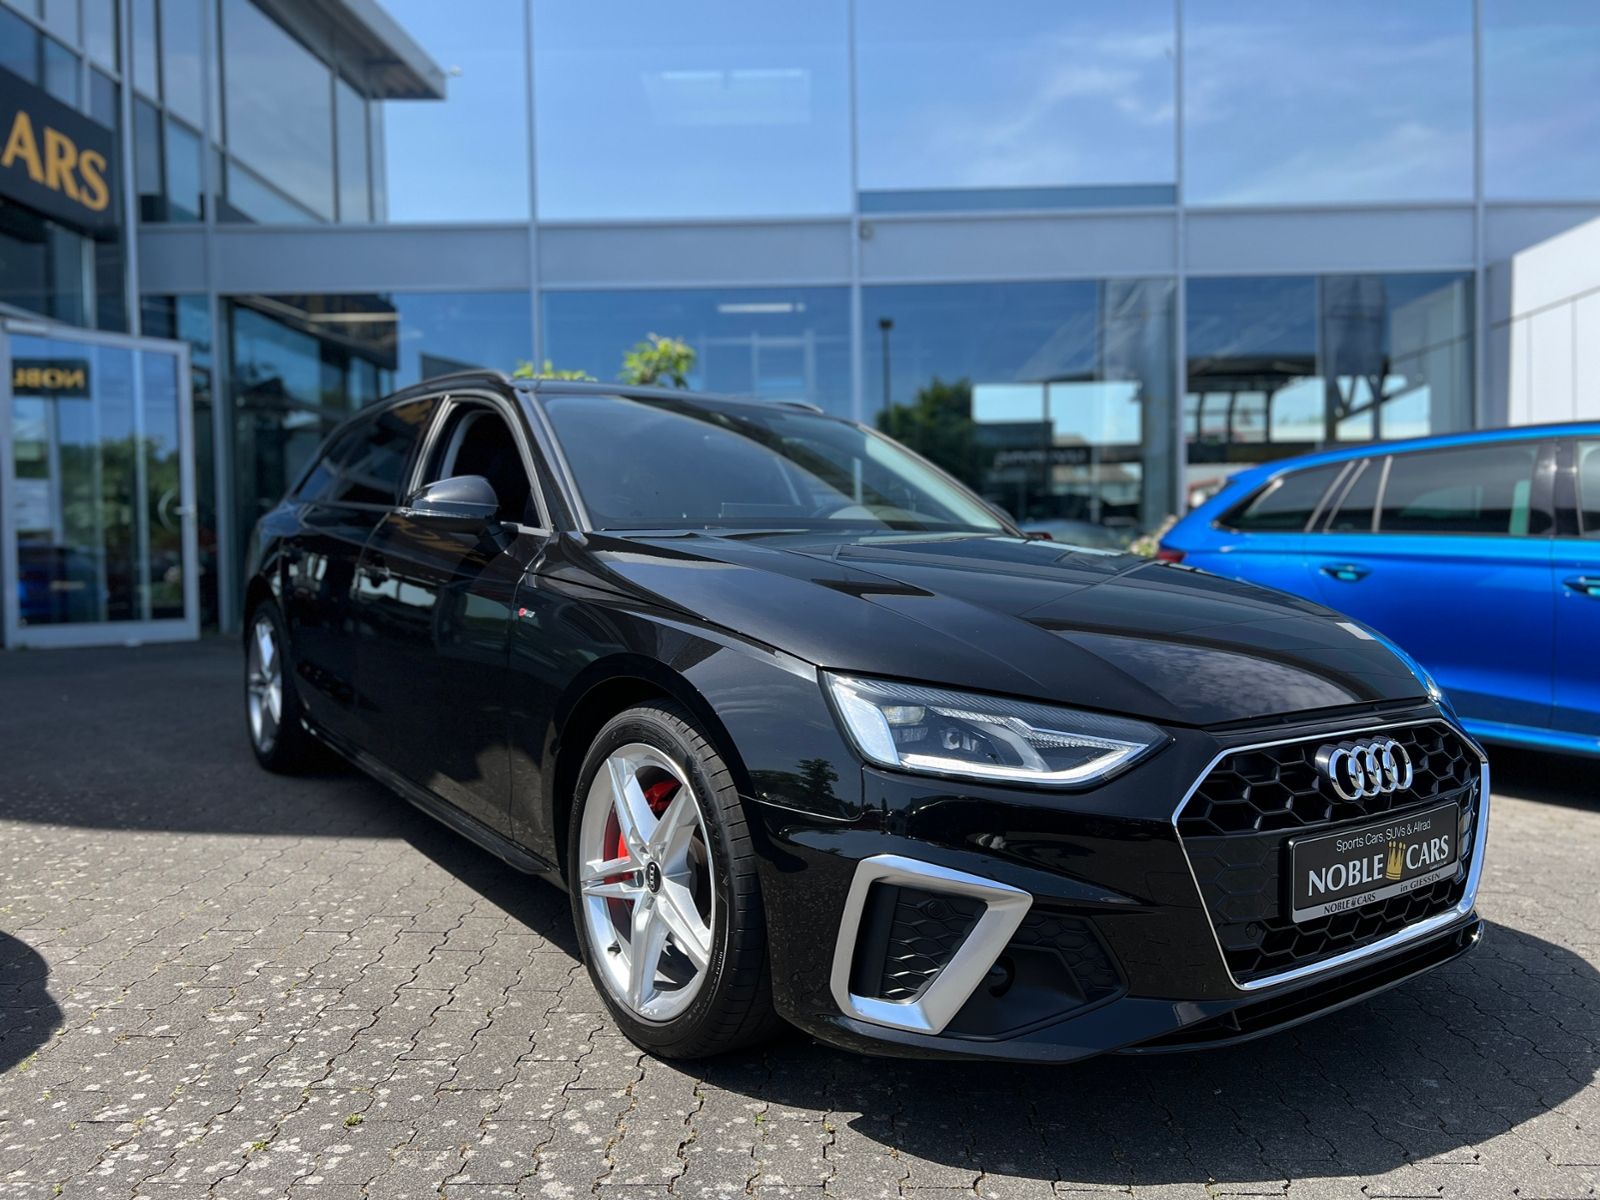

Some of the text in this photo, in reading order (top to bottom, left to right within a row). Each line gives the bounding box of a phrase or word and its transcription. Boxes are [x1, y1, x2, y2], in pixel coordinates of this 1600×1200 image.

[1336, 837, 1364, 853] Sports
[1365, 832, 1386, 845] Cars,
[1406, 823, 1413, 835] &
[1413, 818, 1431, 833] Allrad
[1308, 835, 1449, 897] NOBLE CARS
[1400, 872, 1440, 892] in GIESSEN
[1324, 892, 1376, 914] NOBLE CARS
